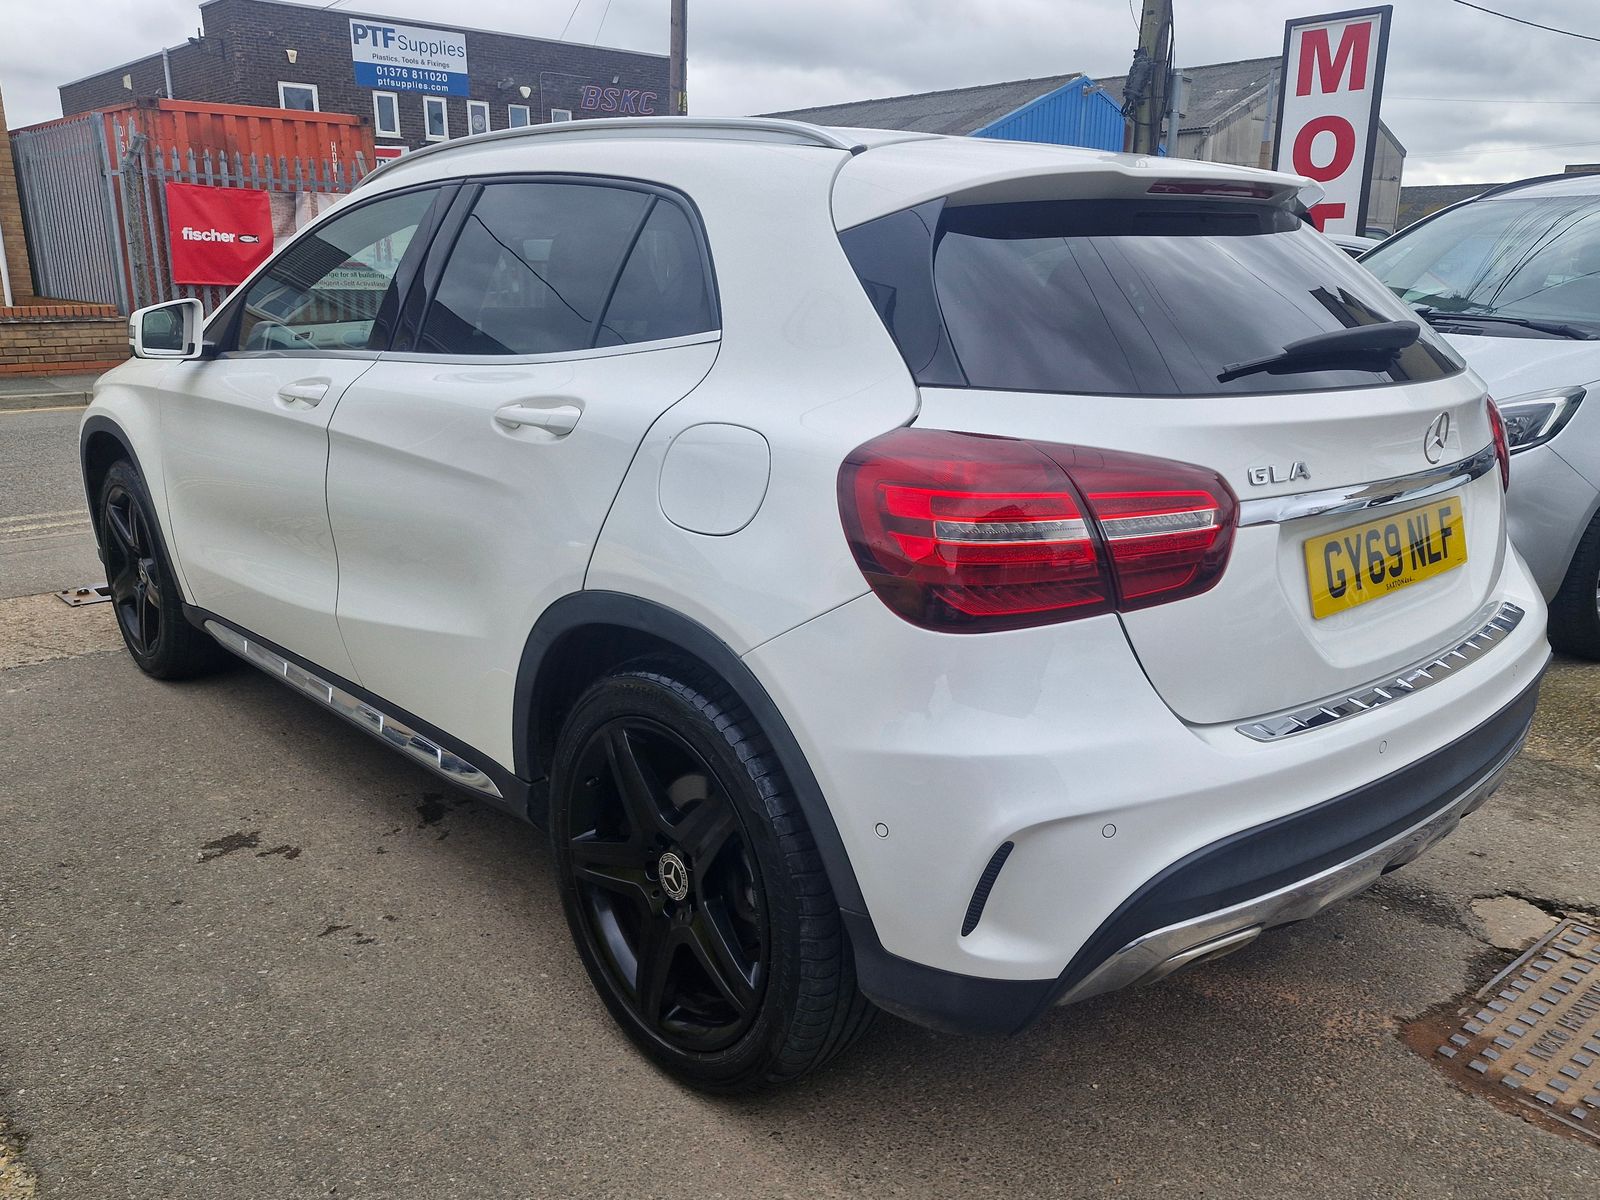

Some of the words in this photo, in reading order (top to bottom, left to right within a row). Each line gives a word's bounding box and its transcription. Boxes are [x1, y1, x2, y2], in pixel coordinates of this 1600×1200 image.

[352, 23, 395, 49] PTF
[398, 34, 465, 57] Supplies
[402, 56, 419, 65] Tools
[427, 60, 450, 69] Fixings
[376, 66, 408, 78] 01376
[412, 70, 448, 82] 811020
[377, 78, 449, 92] ptfsupplies.com
[581, 86, 657, 114] BSKC
[182, 227, 236, 243] fischer
[1248, 461, 1312, 487] GLA
[1323, 523, 1404, 599] GY69
[1406, 506, 1452, 571] NLF
